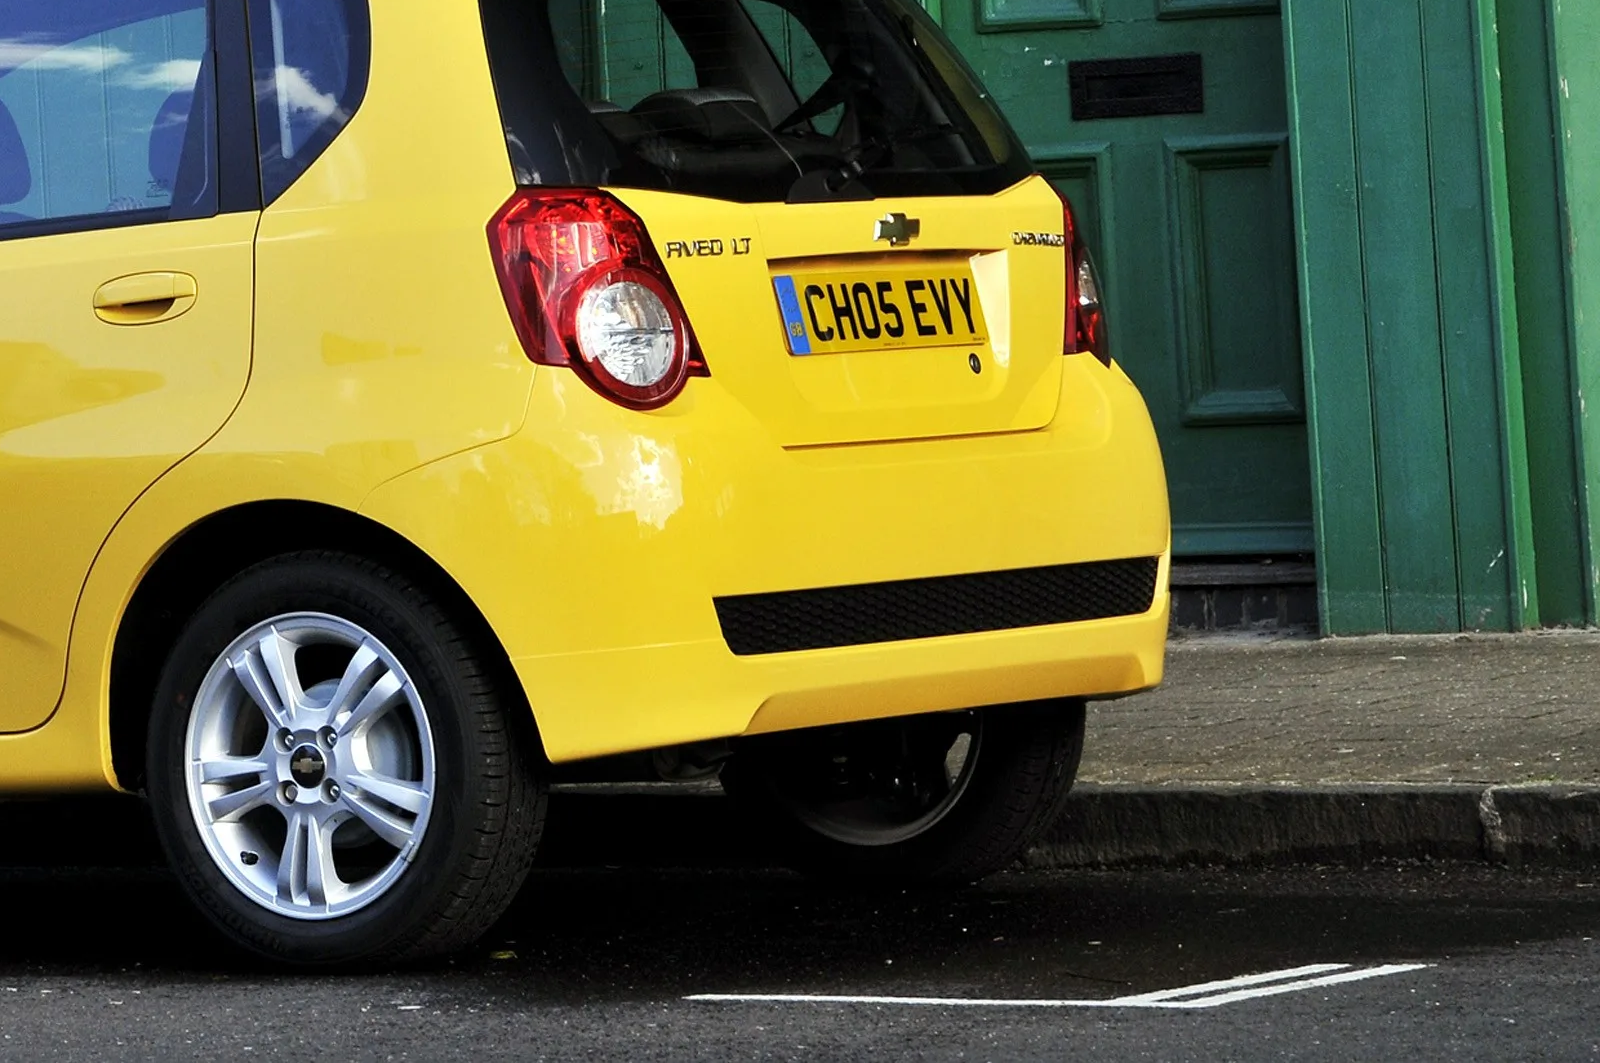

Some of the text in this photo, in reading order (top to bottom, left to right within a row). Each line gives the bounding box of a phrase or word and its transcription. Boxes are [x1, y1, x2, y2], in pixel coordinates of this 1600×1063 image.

[732, 237, 751, 255] LT
[804, 278, 976, 341] CH05 EVY
